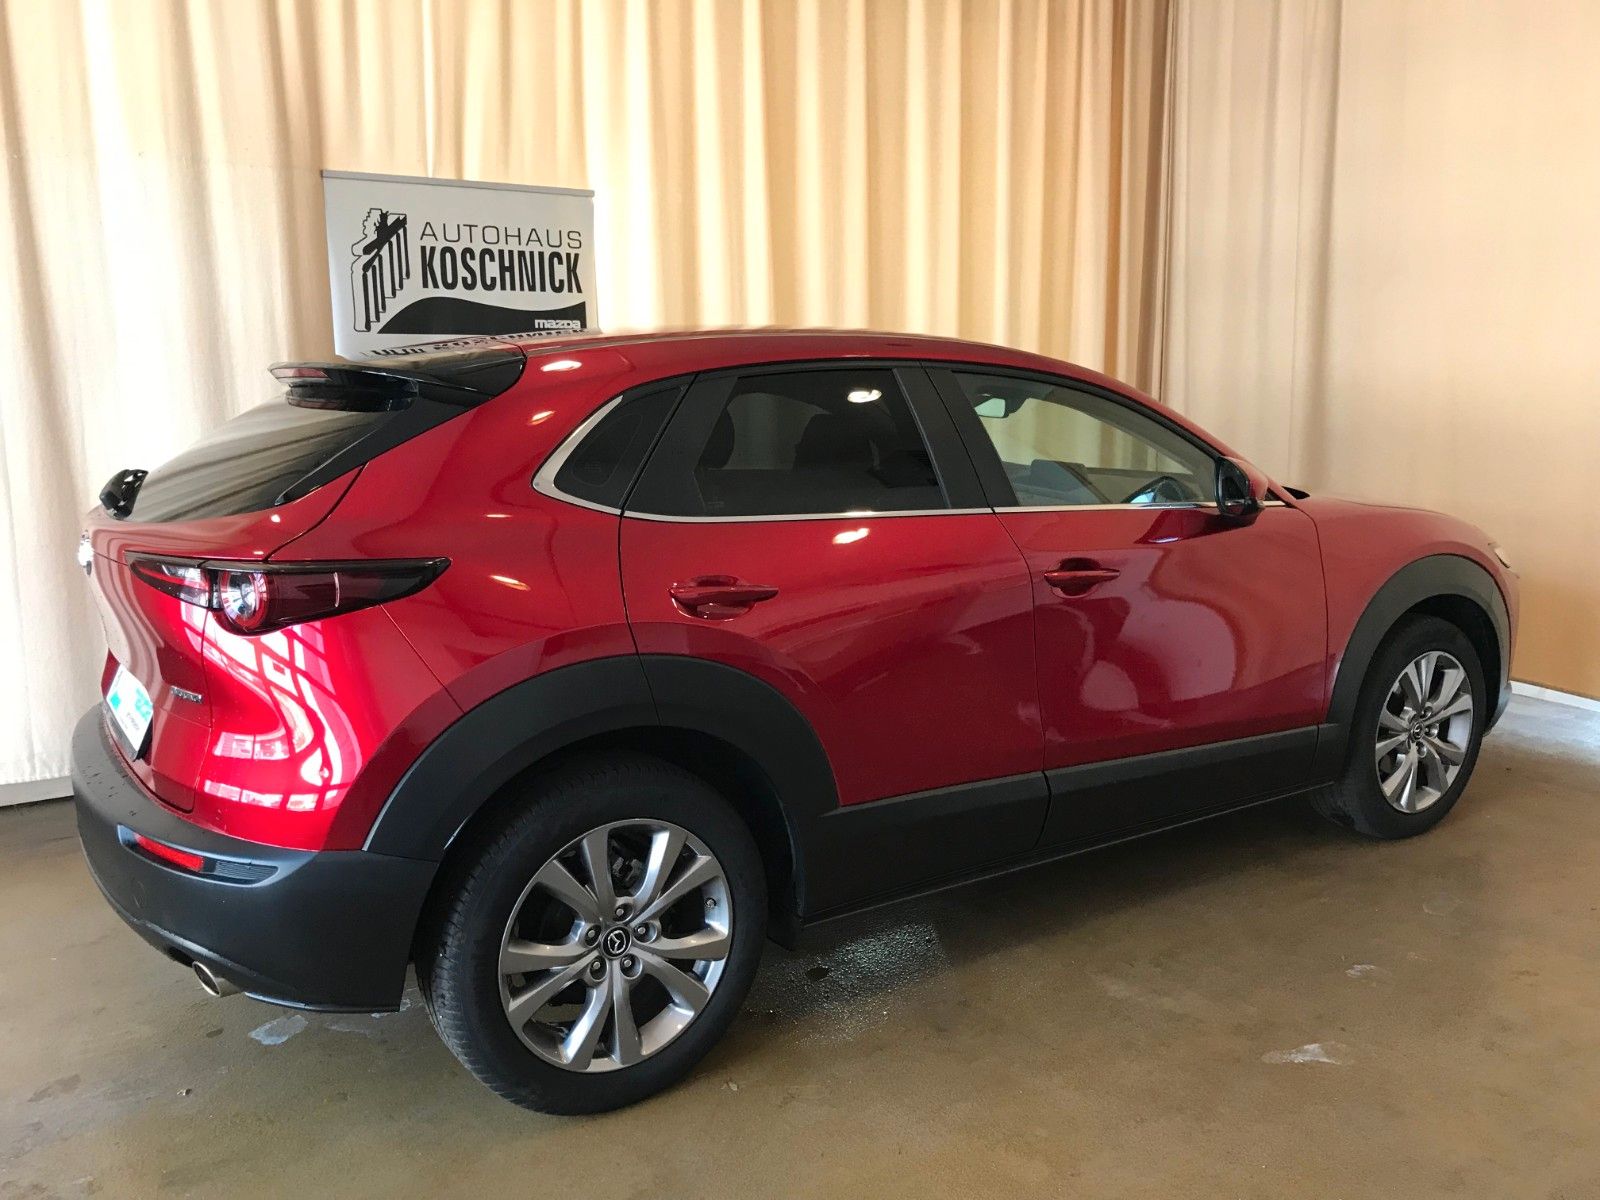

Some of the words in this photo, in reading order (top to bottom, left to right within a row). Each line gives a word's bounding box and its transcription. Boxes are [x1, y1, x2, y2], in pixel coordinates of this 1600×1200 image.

[420, 221, 582, 249] AUTOHAUS
[420, 245, 583, 294] KOSCHNICK
[534, 319, 581, 329] mazda
